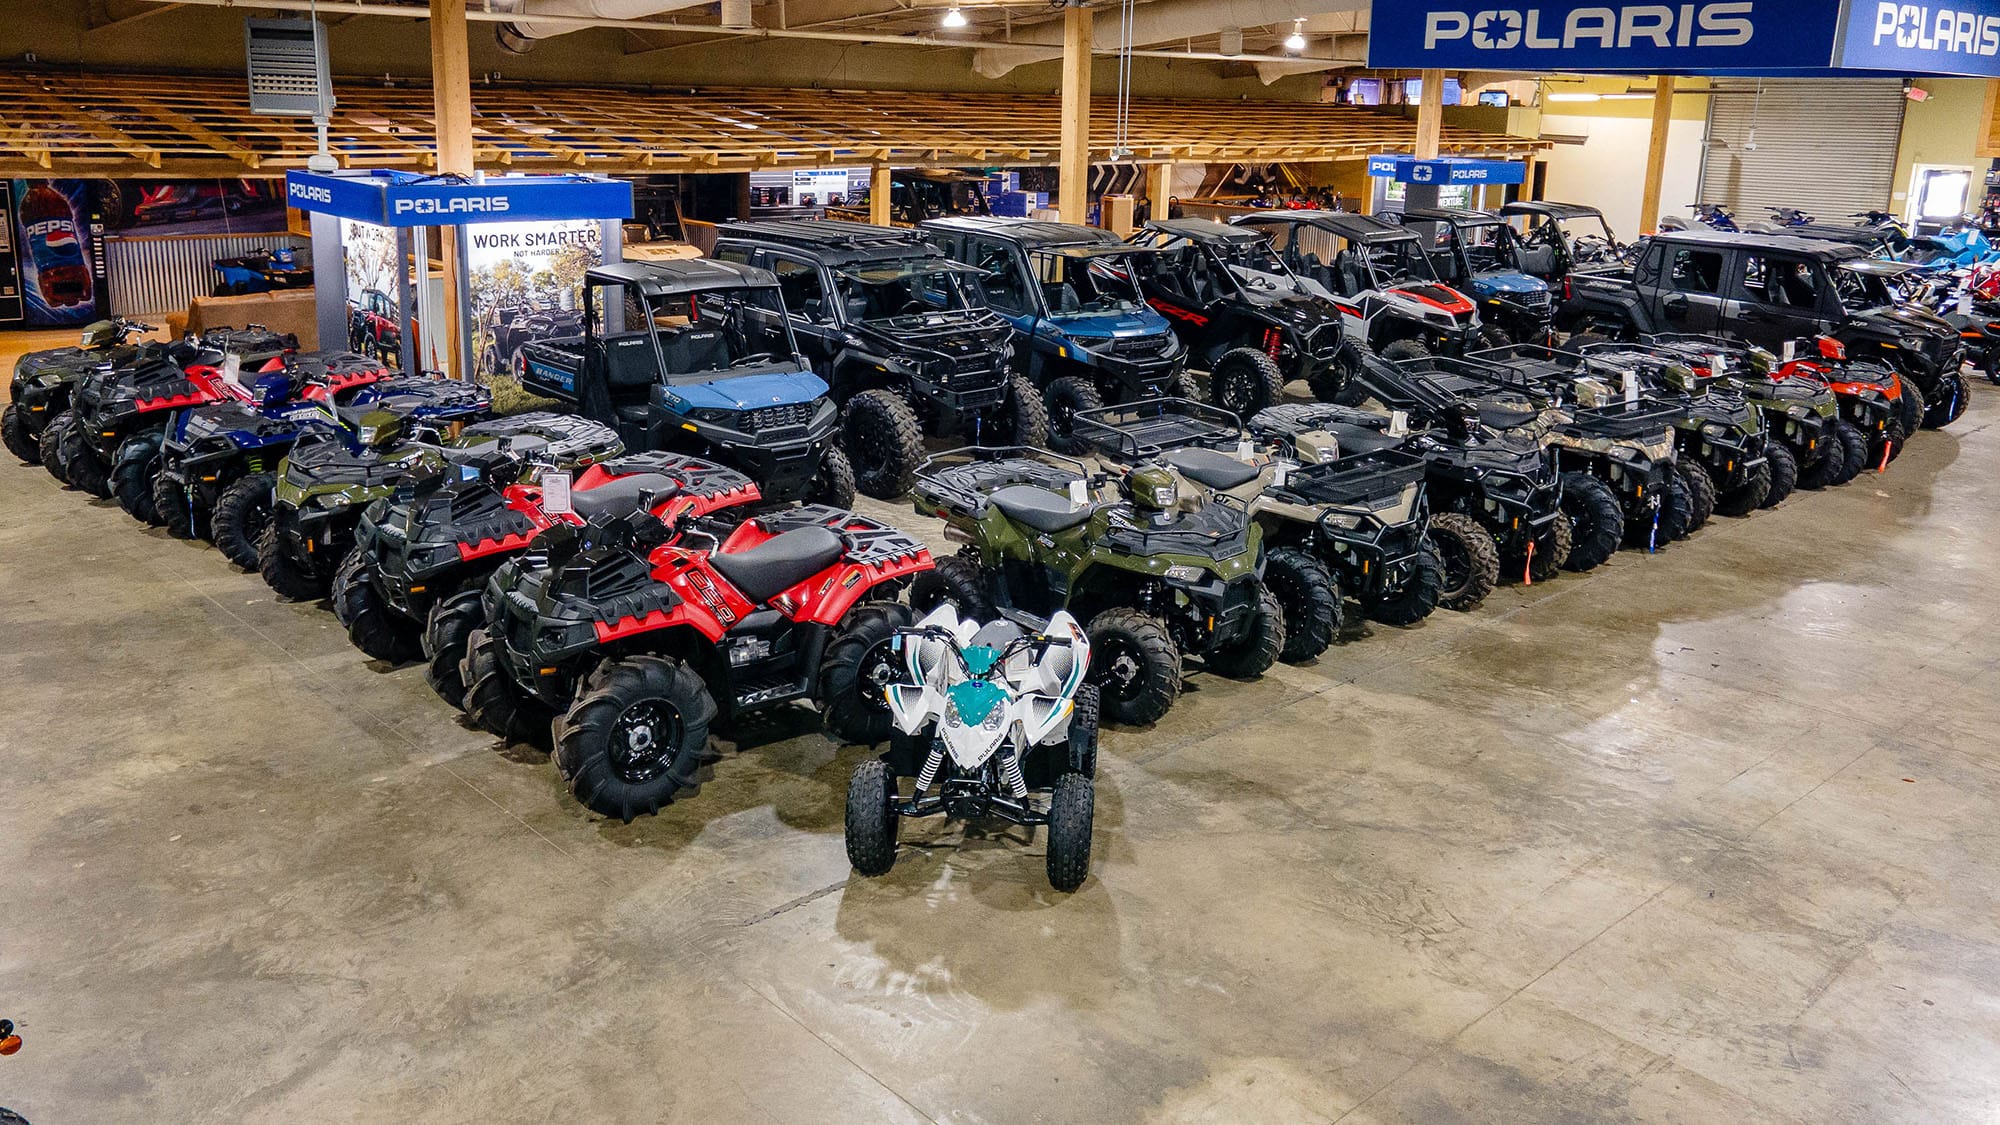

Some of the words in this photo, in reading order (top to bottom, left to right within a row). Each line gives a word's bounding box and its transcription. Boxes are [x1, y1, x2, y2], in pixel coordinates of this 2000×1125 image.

[1424, 2, 1754, 49] POLARIS
[1873, 2, 2000, 56] POLARIS
[1452, 169, 1488, 179] POLARIS
[289, 182, 332, 203] POLARIS
[395, 196, 510, 214] POLARIS
[473, 234, 520, 249] WORK
[525, 229, 596, 247] SMARTER
[513, 250, 528, 258] NOT
[530, 248, 561, 257] HARDER
[536, 367, 573, 385] RANGER
[941, 727, 959, 760] POLARIS
[978, 733, 1003, 762] POLARIS
